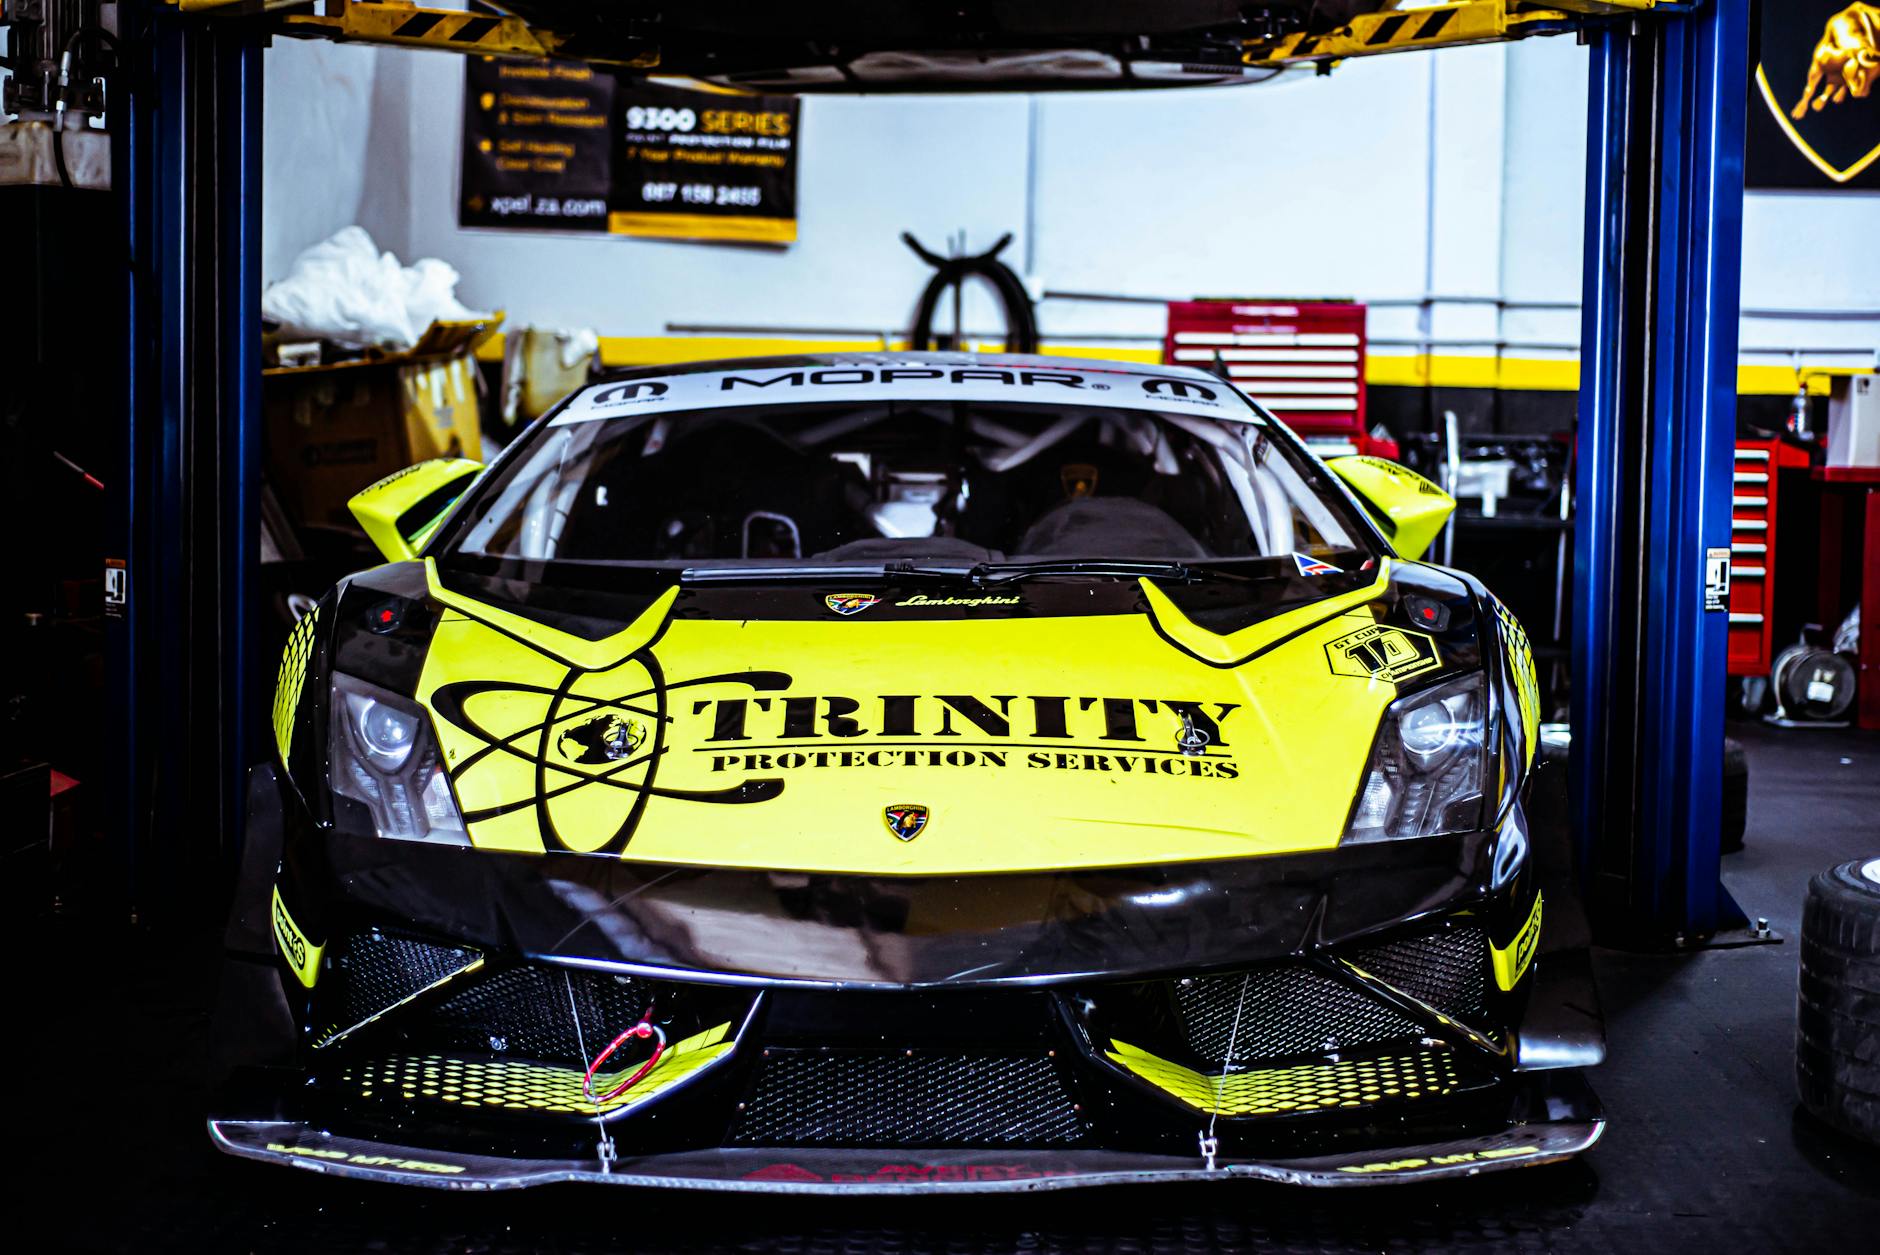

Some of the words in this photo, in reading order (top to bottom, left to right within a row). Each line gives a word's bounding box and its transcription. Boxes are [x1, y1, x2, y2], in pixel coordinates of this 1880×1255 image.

[627, 106, 696, 131] 9300
[702, 110, 791, 136] SERIES
[895, 594, 1020, 607] Lamborghini
[1334, 638, 1351, 650] GT
[1354, 627, 1379, 640] CUP
[692, 694, 1242, 748] TRINITY
[711, 749, 1009, 772] PROTECTION
[1027, 751, 1239, 779] SERVICES
